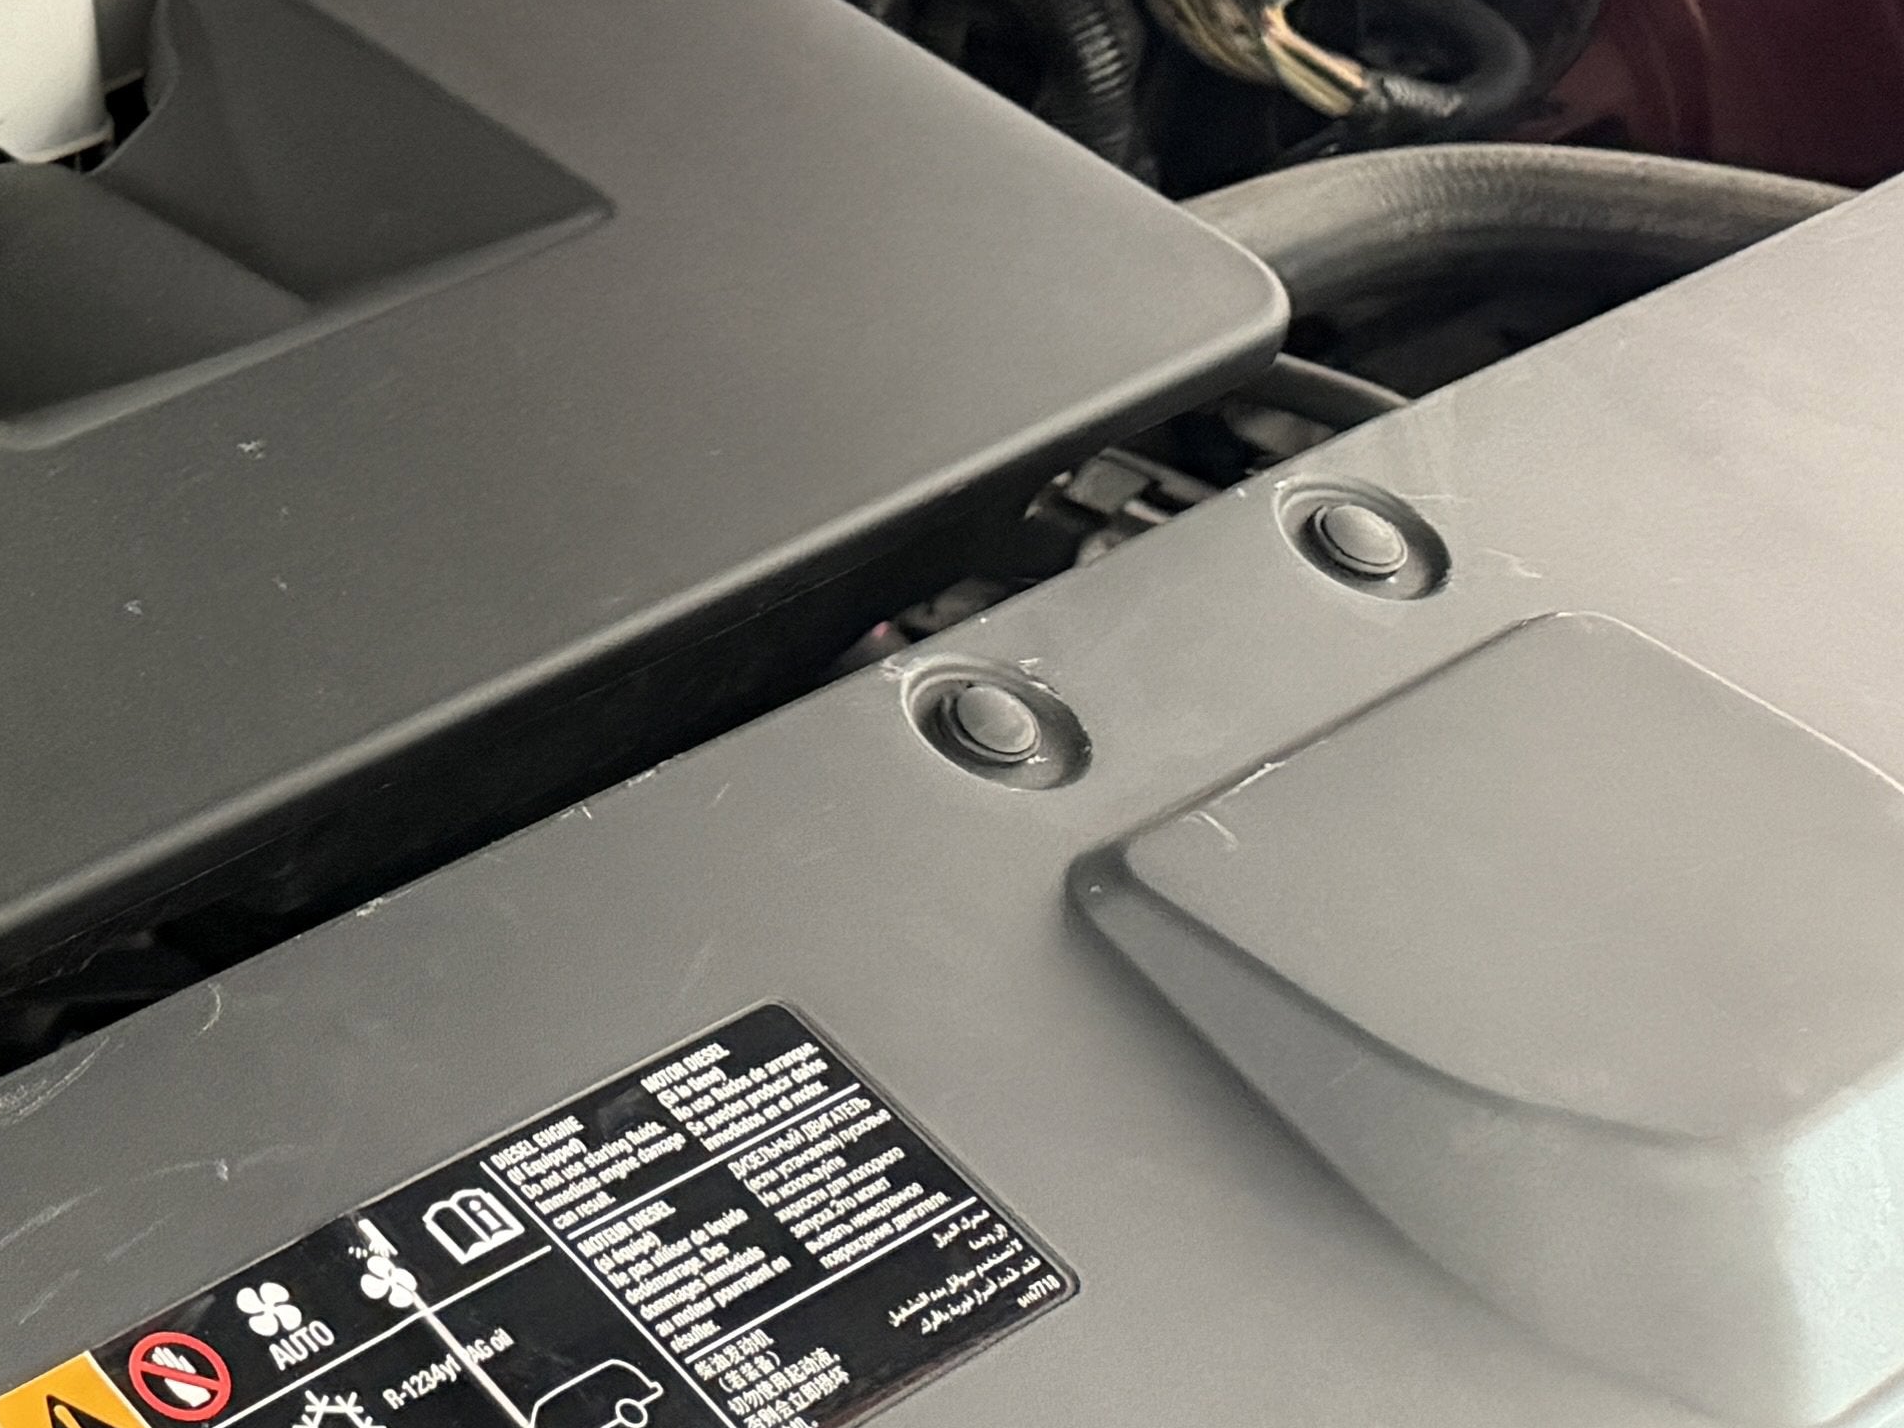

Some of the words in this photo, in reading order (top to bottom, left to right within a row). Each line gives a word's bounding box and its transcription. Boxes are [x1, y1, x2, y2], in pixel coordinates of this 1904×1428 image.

[640, 1061, 689, 1093] MOTOR
[682, 1042, 730, 1072] DIESEL
[669, 1105, 694, 1122] No
[690, 1094, 715, 1113] use
[709, 1074, 753, 1102] fluidos
[748, 1067, 768, 1083] de
[764, 1042, 819, 1075] arranque.
[672, 1084, 692, 1099] lo
[685, 1120, 708, 1137] Se
[704, 1099, 749, 1130] pueden
[745, 1075, 793, 1109] producir
[699, 1112, 766, 1152] inmediatos
[762, 1104, 782, 1120] en
[778, 1095, 793, 1111] el
[790, 1080, 829, 1106] motor.
[490, 1139, 539, 1170] DIESEL
[532, 1115, 584, 1149] ENGINE
[520, 1137, 587, 1177] Equipped)
[520, 1183, 543, 1200] Do
[540, 1170, 565, 1191] not
[560, 1161, 587, 1180] use
[583, 1138, 633, 1168] starting
[625, 1121, 666, 1146] fluids.
[727, 1127, 806, 1180] ДИЗЕЛЬНЫЙ
[799, 1097, 871, 1142] ДВИГАТЕЛЬ
[534, 1176, 601, 1215] Immediate
[598, 1155, 641, 1184] engine
[637, 1132, 686, 1163] damage
[756, 1191, 780, 1208] Не
[776, 1155, 846, 1199] используйте
[552, 1210, 579, 1230] can
[575, 1190, 616, 1218] result.
[576, 1220, 633, 1258] MOTEUR
[626, 1200, 676, 1231] DIESEL
[606, 1271, 631, 1289] Ne
[627, 1259, 654, 1282] pas
[650, 1237, 693, 1267] utiliser
[689, 1229, 710, 1246] de
[703, 1208, 748, 1237] liquide
[699, 1242, 730, 1263] Des
[639, 1273, 707, 1321] dommages
[696, 1246, 765, 1286] immédiats
[654, 1319, 675, 1337] au
[671, 1296, 716, 1327] moteur
[712, 1262, 776, 1308] pourraient
[771, 1255, 791, 1273] en
[268, 1320, 335, 1371] AUTO
[382, 1353, 461, 1409] R-1234yf
[489, 1327, 514, 1352] oil
[694, 1328, 774, 1381] 柴油发动机
